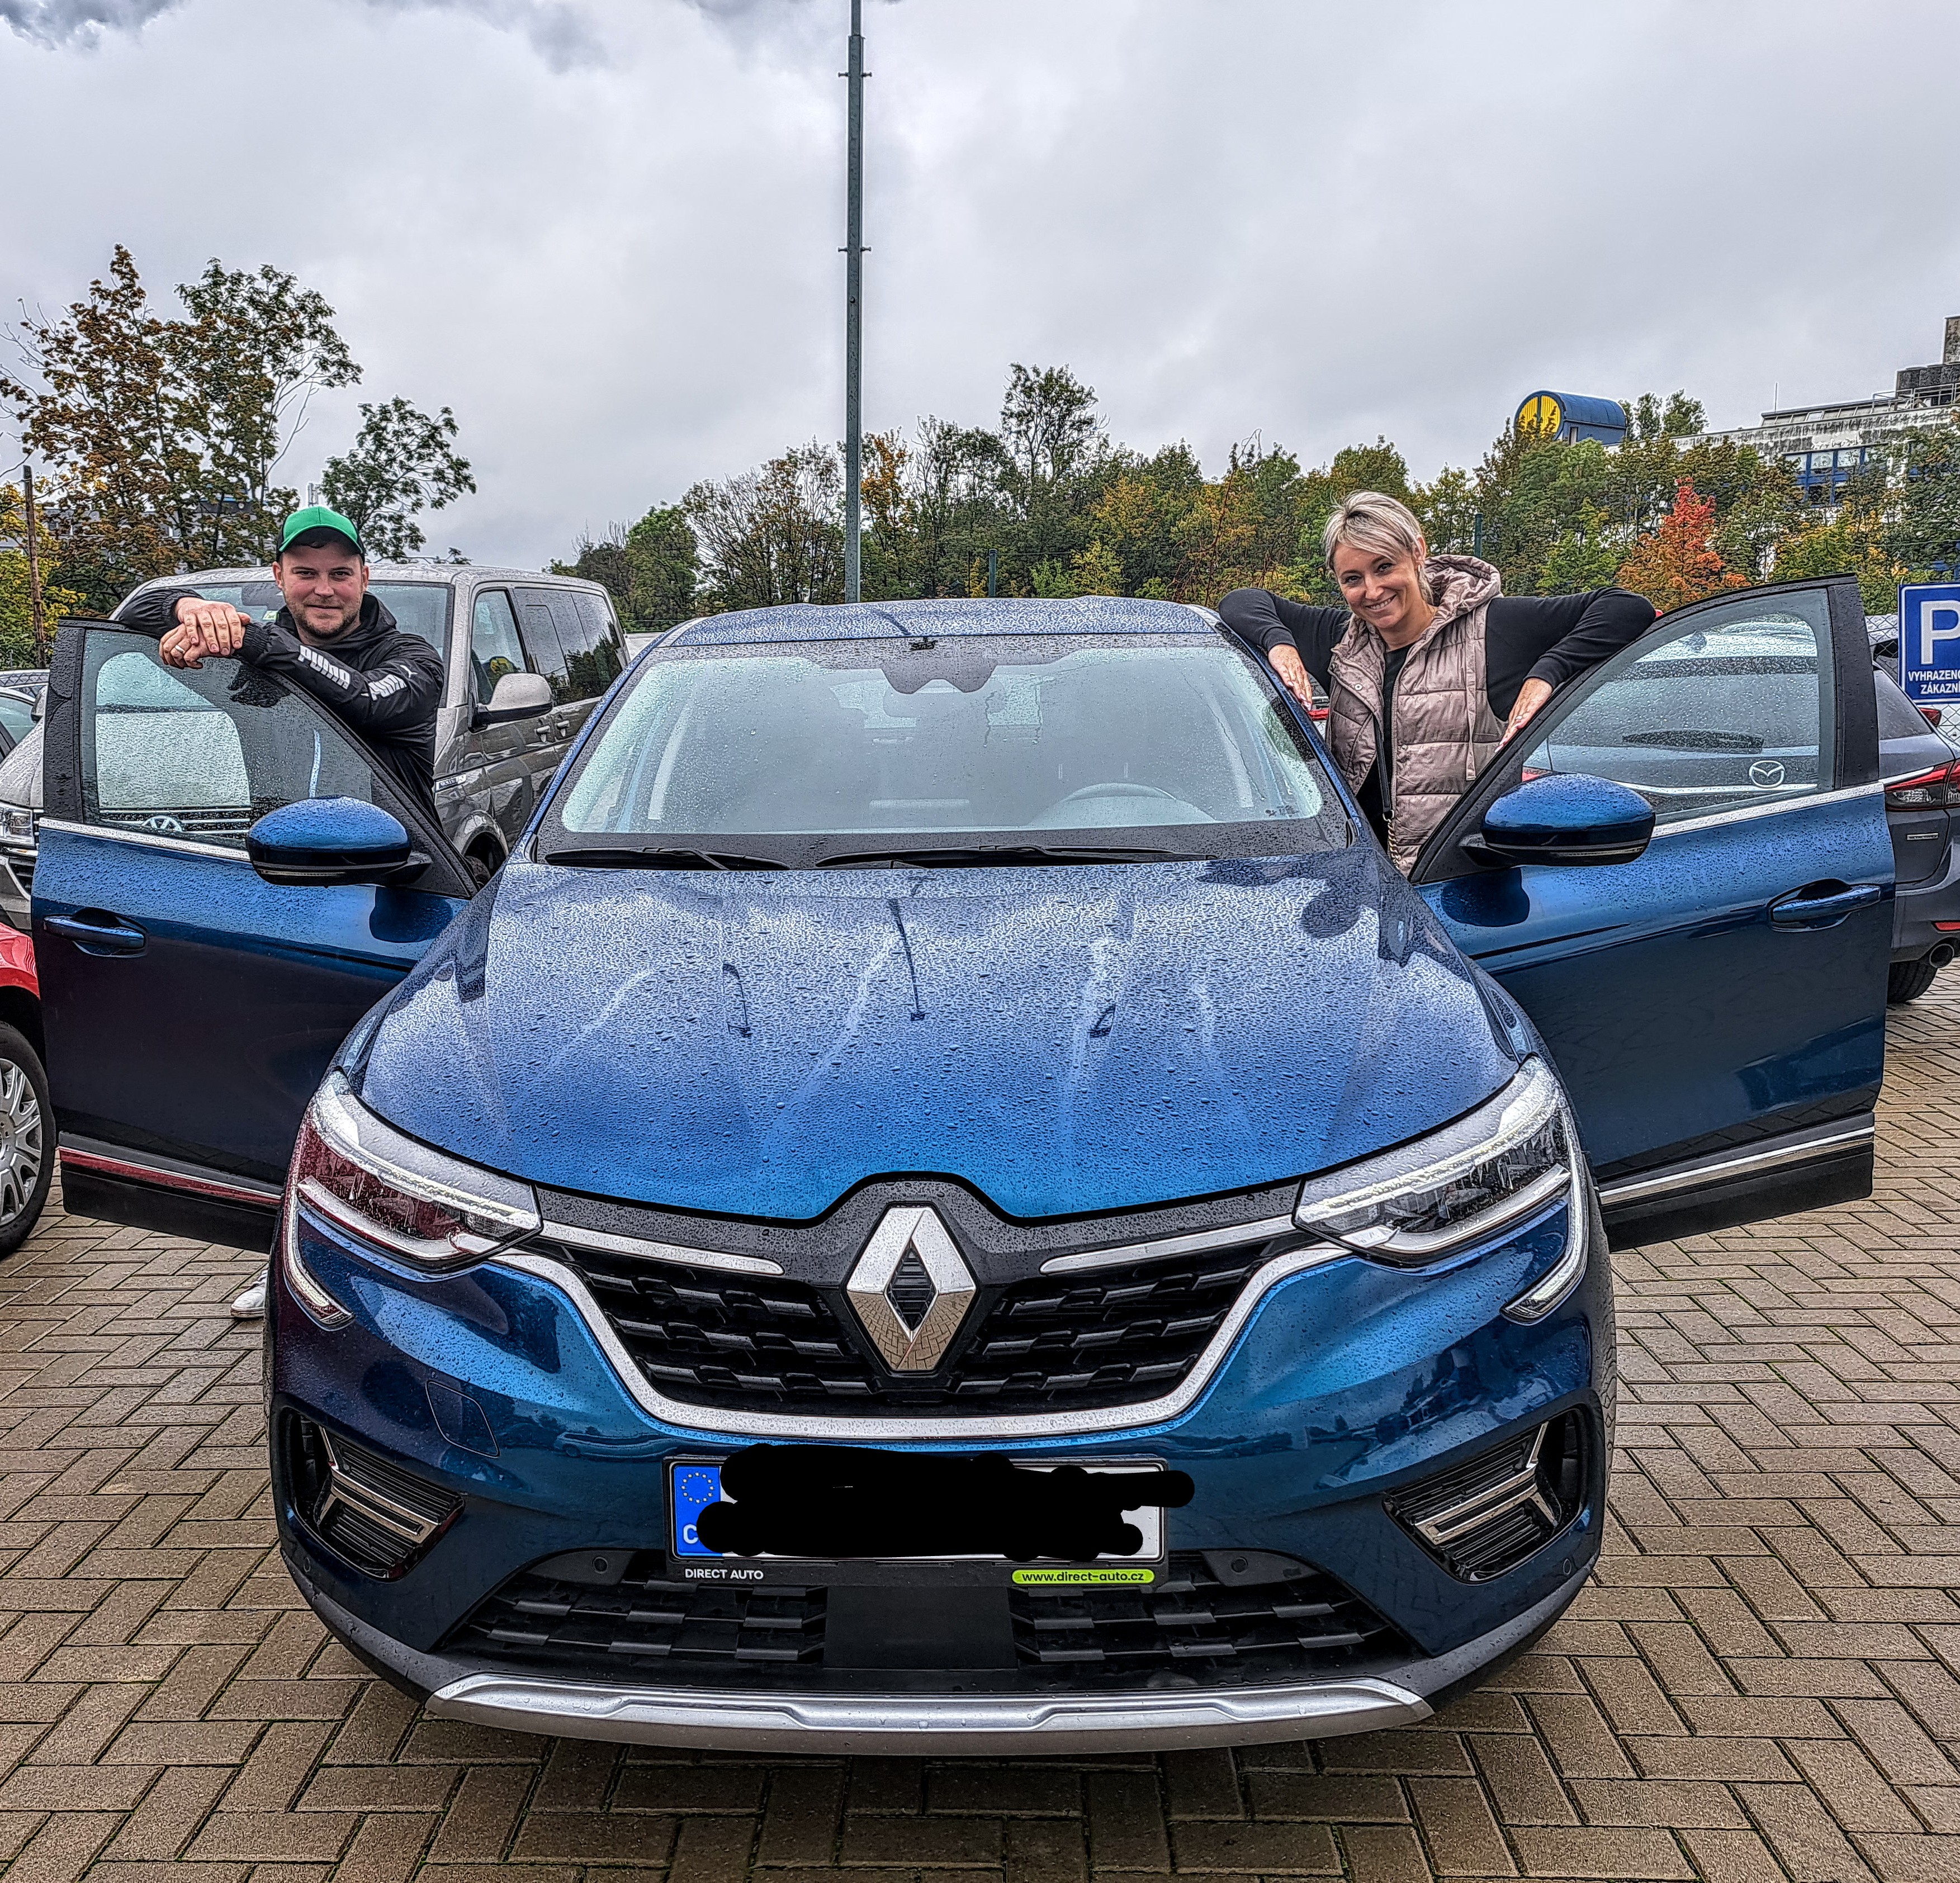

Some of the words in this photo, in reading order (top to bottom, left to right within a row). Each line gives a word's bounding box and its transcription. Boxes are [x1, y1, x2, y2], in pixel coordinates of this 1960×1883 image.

[1920, 600, 1960, 665] P
[297, 645, 350, 690] PUMA
[685, 1568, 728, 1579] DIRECT
[730, 1569, 764, 1580] AUTO
[1022, 1572, 1144, 1582] www.direct-auto.cz
